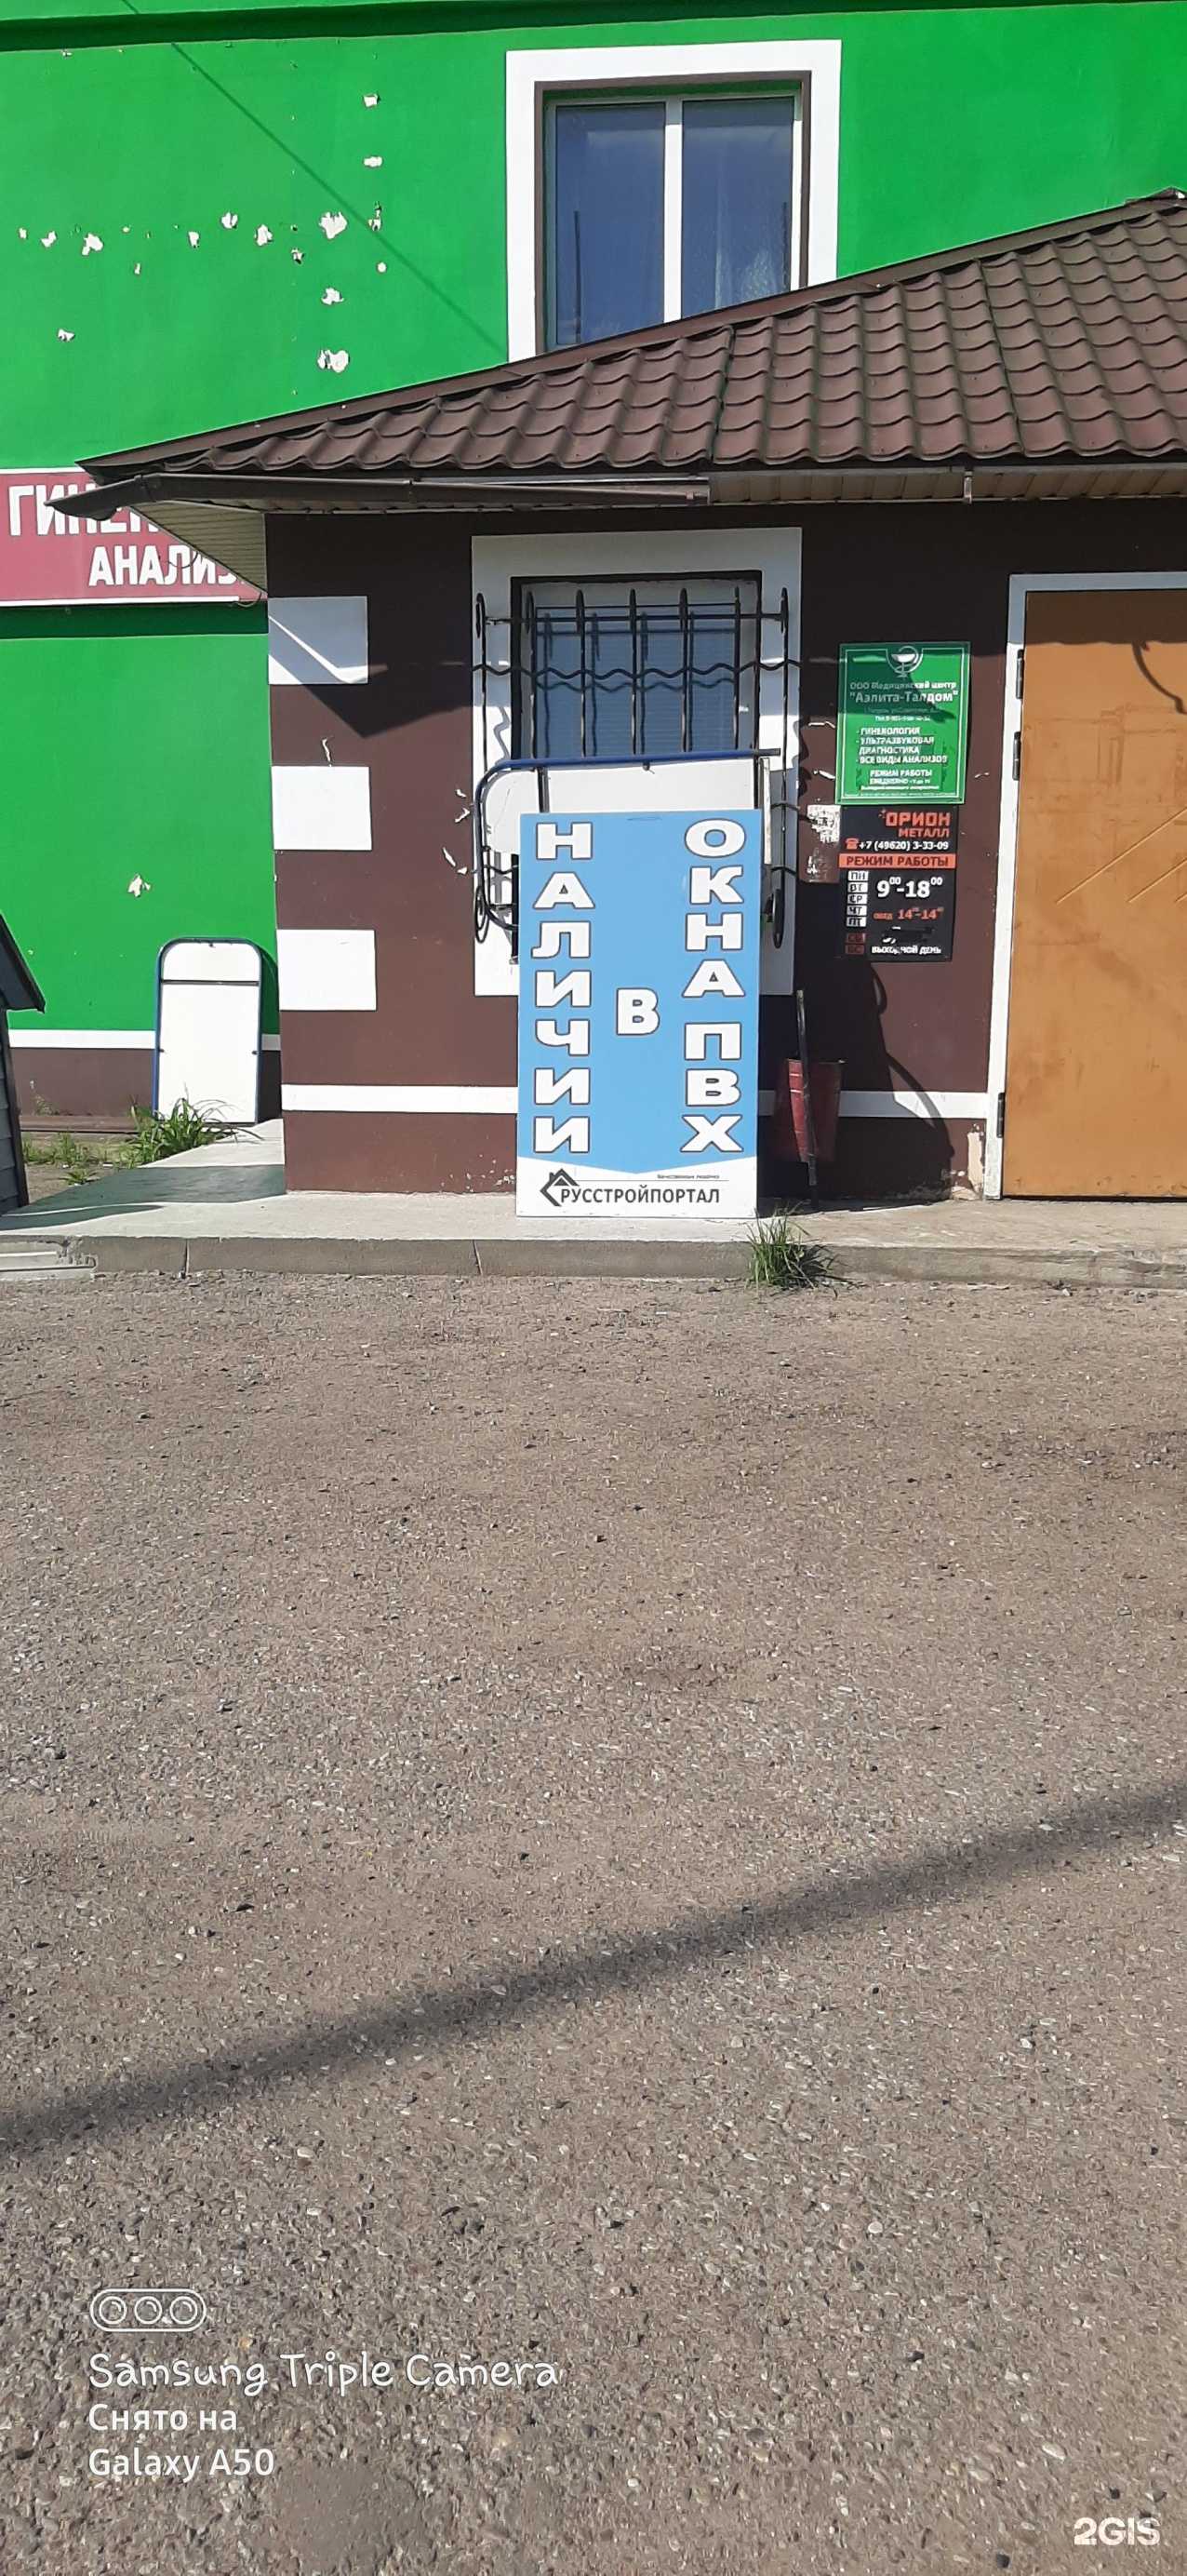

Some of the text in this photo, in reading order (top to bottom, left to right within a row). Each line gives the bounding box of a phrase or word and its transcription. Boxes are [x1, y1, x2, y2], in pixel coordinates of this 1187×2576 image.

[849, 681, 870, 691] ООО
[849, 690, 959, 705] "Аэлита-Талдом"
[860, 727, 921, 736] ГИНЕКОЛОГИЯ
[860, 736, 935, 745] УЛЬТРАЗВУКОВАЯ
[859, 745, 920, 756] ДИАГНОСТИКА
[860, 754, 948, 764] ВСЕ ВИДЫ АНАЛИЗОВ
[900, 769, 932, 777] РАБОТЫ
[886, 812, 951, 826] ОРИОН
[899, 828, 950, 838] МЕТАЛЛ
[859, 840, 949, 852] +7 (49620) 3-33-09
[847, 856, 949, 866] РЕЖИМ РАБОТЫ
[850, 872, 866, 880] ПН
[850, 883, 863, 892] ВТ
[849, 894, 863, 903] СР
[681, 818, 746, 998] ОКНА
[849, 906, 863, 915] ЧТ
[848, 918, 863, 926] ПТ
[530, 821, 595, 1154] НАЛИЧИИ
[615, 987, 660, 1037] В
[679, 1021, 744, 1153] ПВХ
[560, 1184, 721, 1205] РУССТРОЙПОРТАЛ
